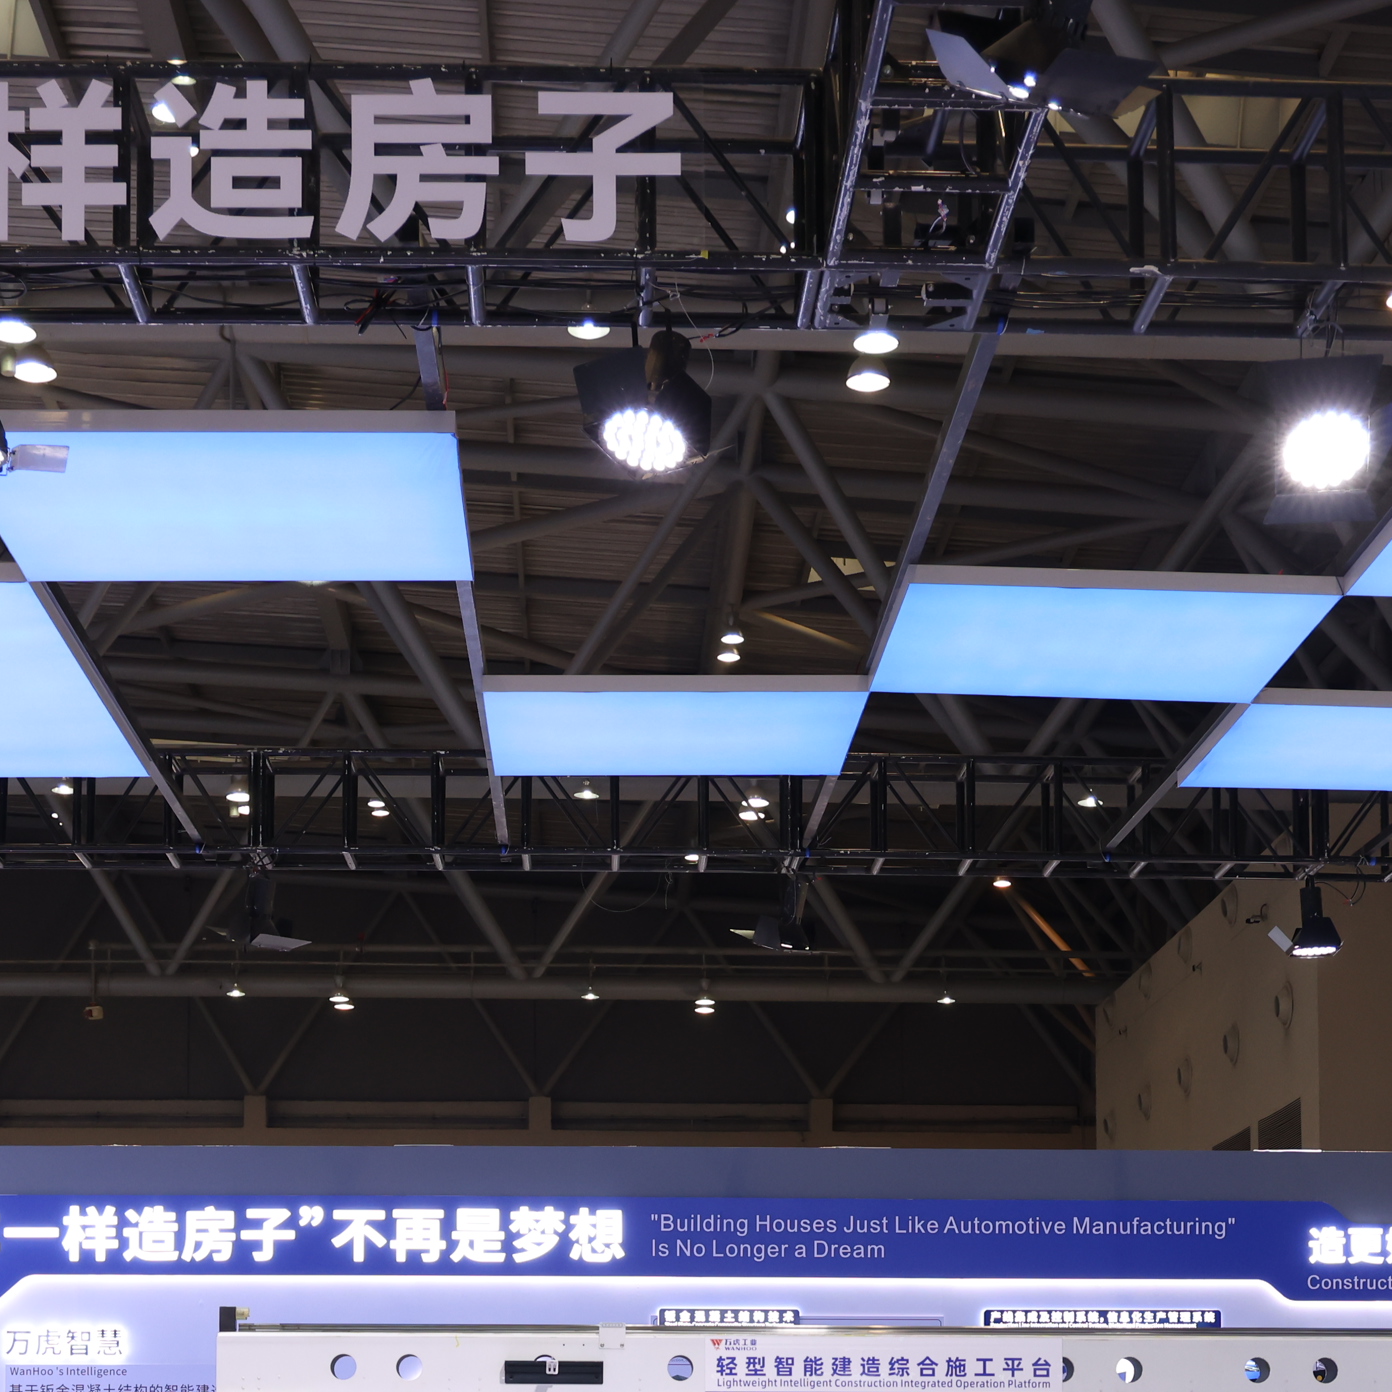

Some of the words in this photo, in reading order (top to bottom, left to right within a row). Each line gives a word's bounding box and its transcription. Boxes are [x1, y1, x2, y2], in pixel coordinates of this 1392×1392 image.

[756, 1215, 837, 1233] Houses
[844, 1216, 889, 1233] Just
[895, 1216, 939, 1234] Like
[943, 1216, 1066, 1234] Automotive
[652, 1239, 669, 1257] Is
[676, 1239, 706, 1257] No
[713, 1240, 789, 1262] Longer
[794, 1244, 807, 1258] a
[814, 1241, 885, 1258] Dream
[1307, 1275, 1392, 1290] Construct
[6, 1329, 122, 1356] 万虎智慧
[10, 1367, 54, 1376] WanHoo
[66, 1367, 127, 1379] Intelligence
[716, 1356, 1052, 1377] 轻型智能建造综合施工平台
[717, 1378, 778, 1389] Lightweight
[780, 1379, 833, 1389] Intelligent
[835, 1379, 898, 1388] Construction
[900, 1379, 953, 1389] Integrated
[956, 1379, 1005, 1390] Operation
[1007, 1379, 1051, 1388] Platform
